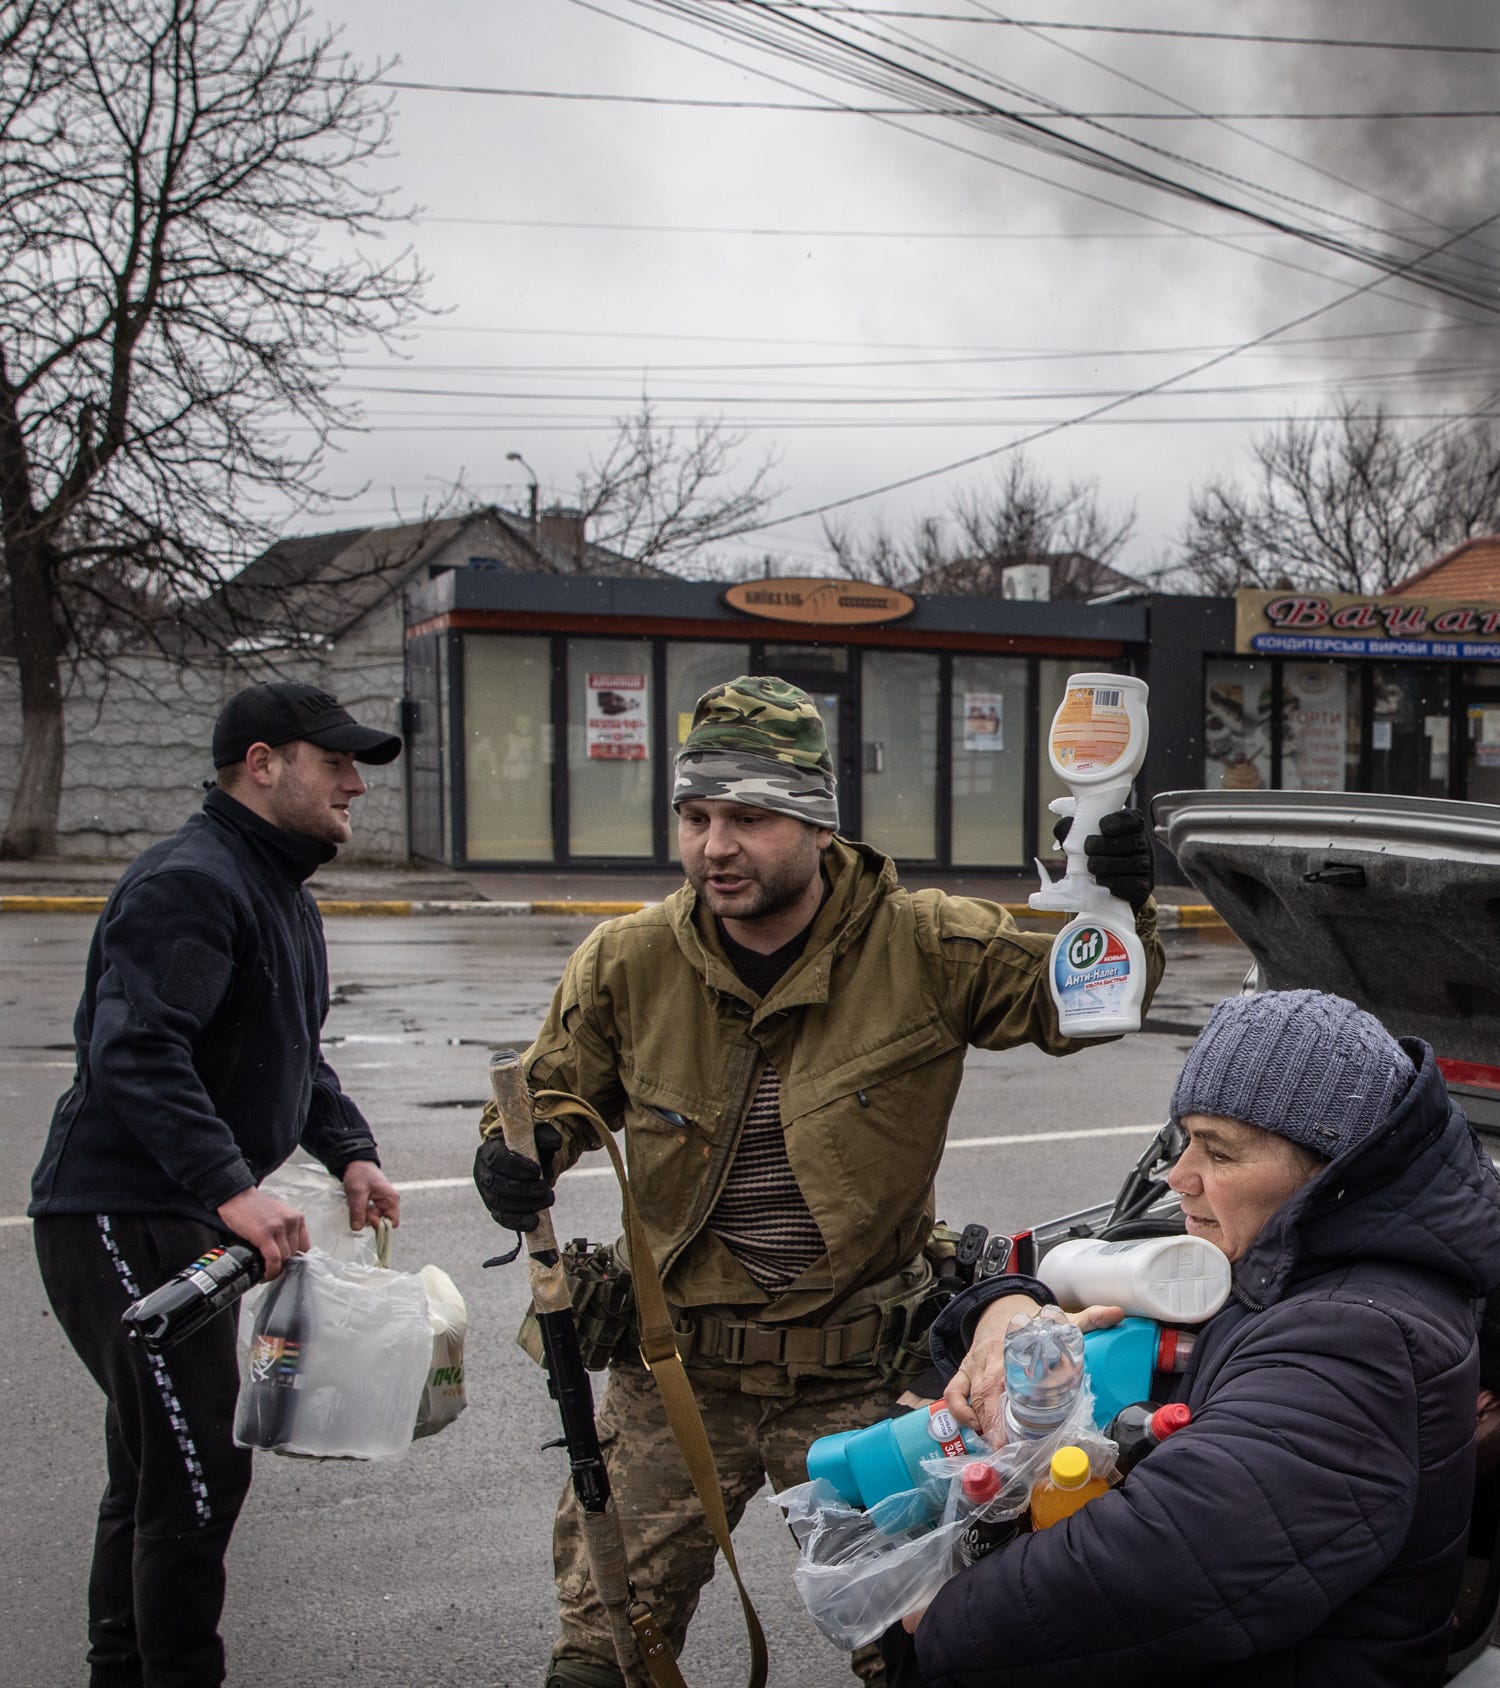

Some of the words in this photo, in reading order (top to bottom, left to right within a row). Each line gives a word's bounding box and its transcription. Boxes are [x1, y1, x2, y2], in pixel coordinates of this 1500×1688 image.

[1256, 636, 1365, 652] КОНДИТЕРСЬКІ
[1369, 641, 1428, 654] ВИРОБИ
[1432, 643, 1457, 656] ВІД
[1071, 932, 1098, 964] Cif
